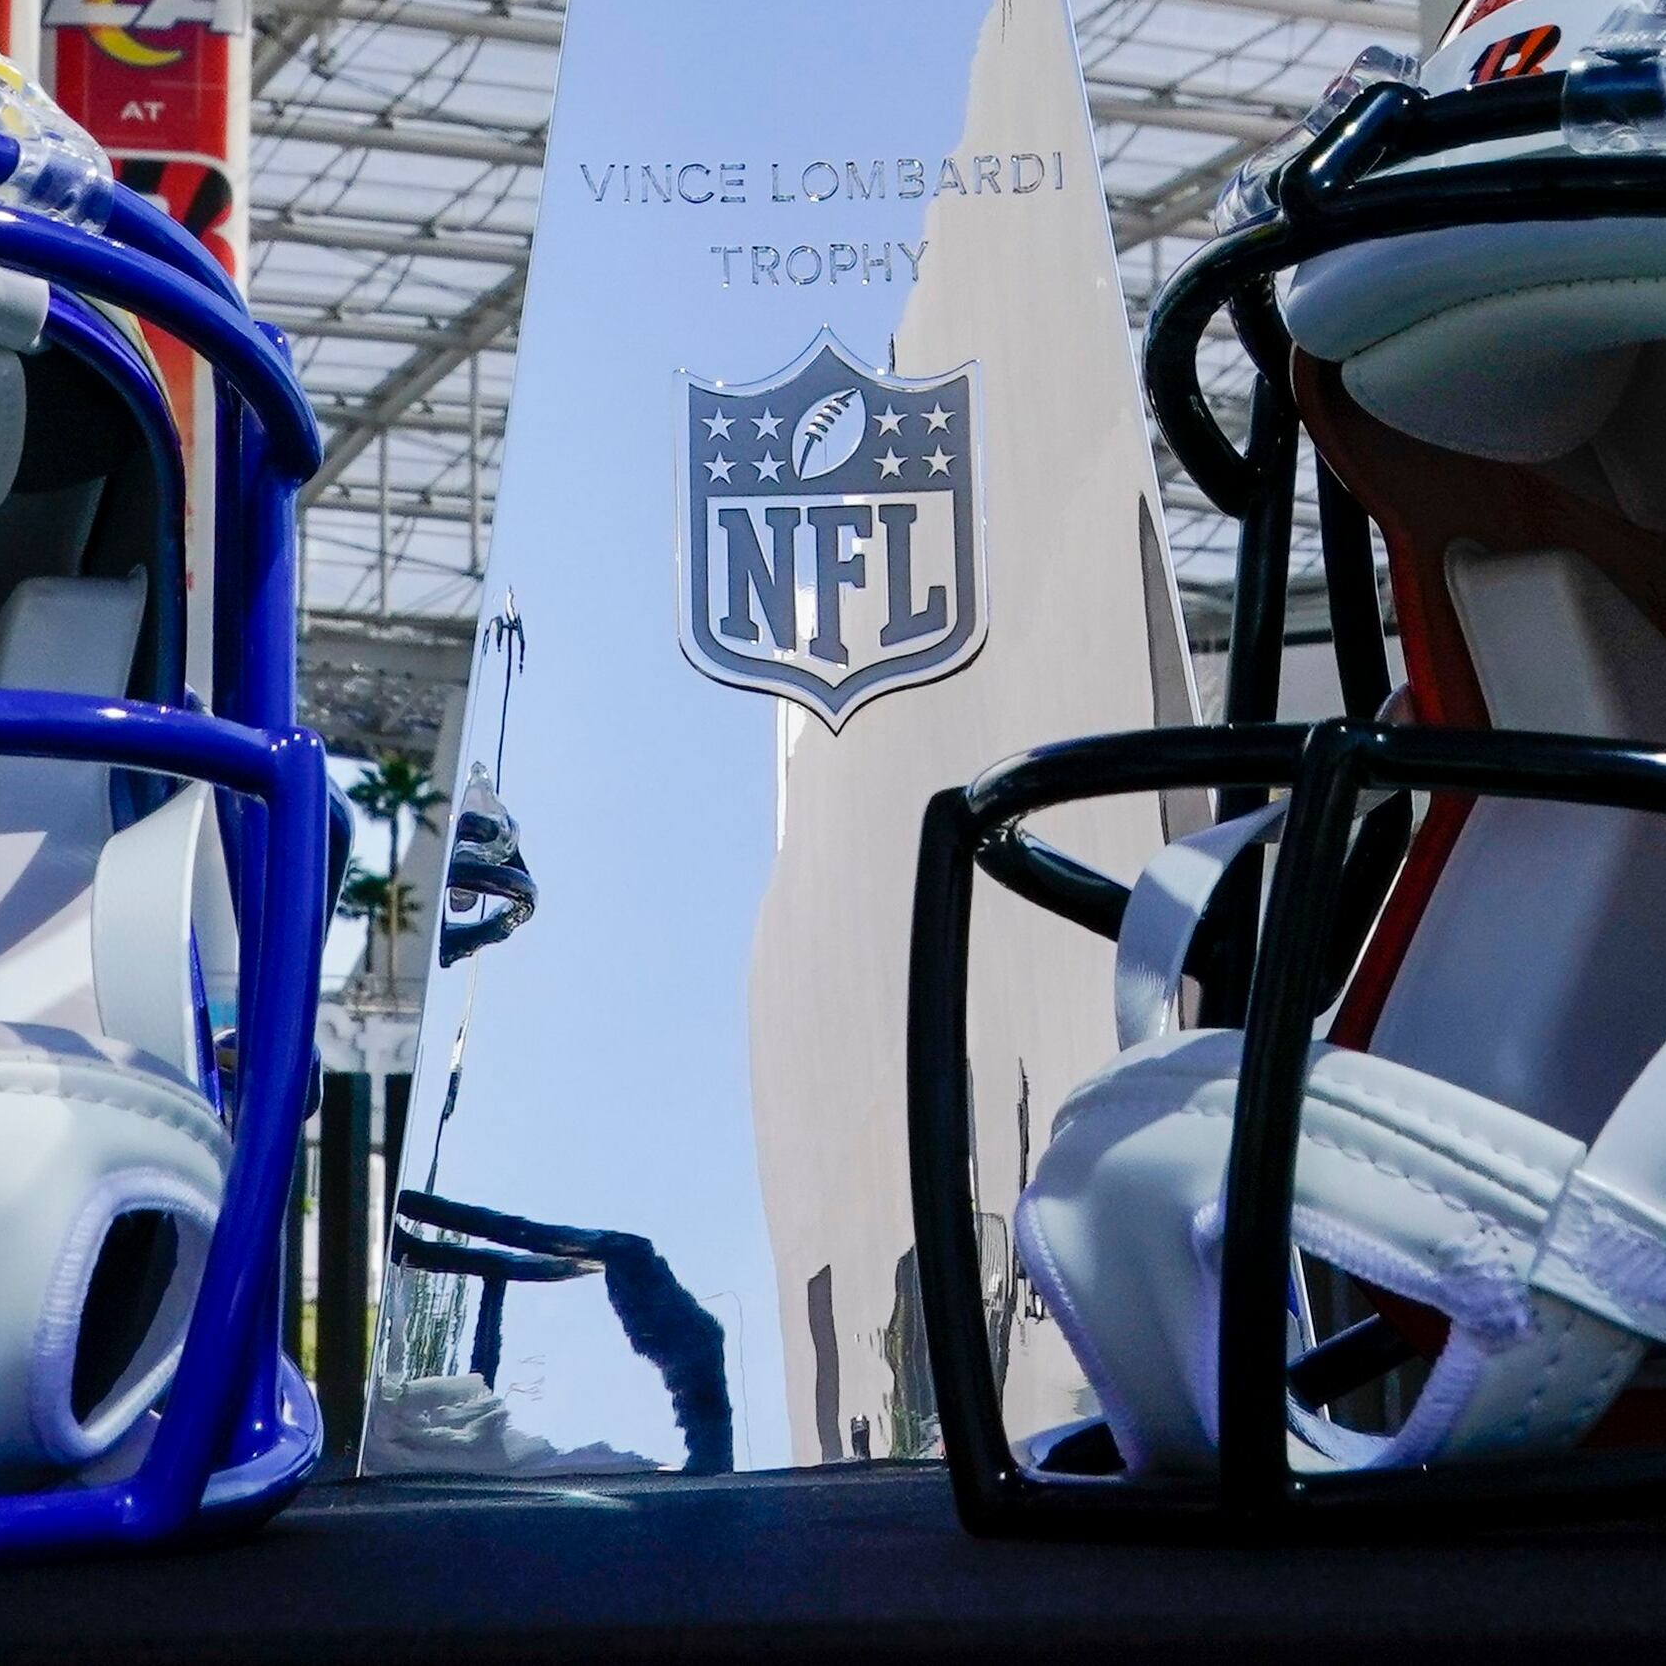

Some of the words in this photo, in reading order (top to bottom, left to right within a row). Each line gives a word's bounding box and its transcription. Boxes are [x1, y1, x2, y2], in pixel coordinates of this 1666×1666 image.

[120, 100, 167, 122] AT
[579, 162, 747, 204] VINCE
[771, 151, 1064, 202] LOMBARDI
[709, 241, 929, 288] TROPHY
[717, 505, 948, 667] NFL
